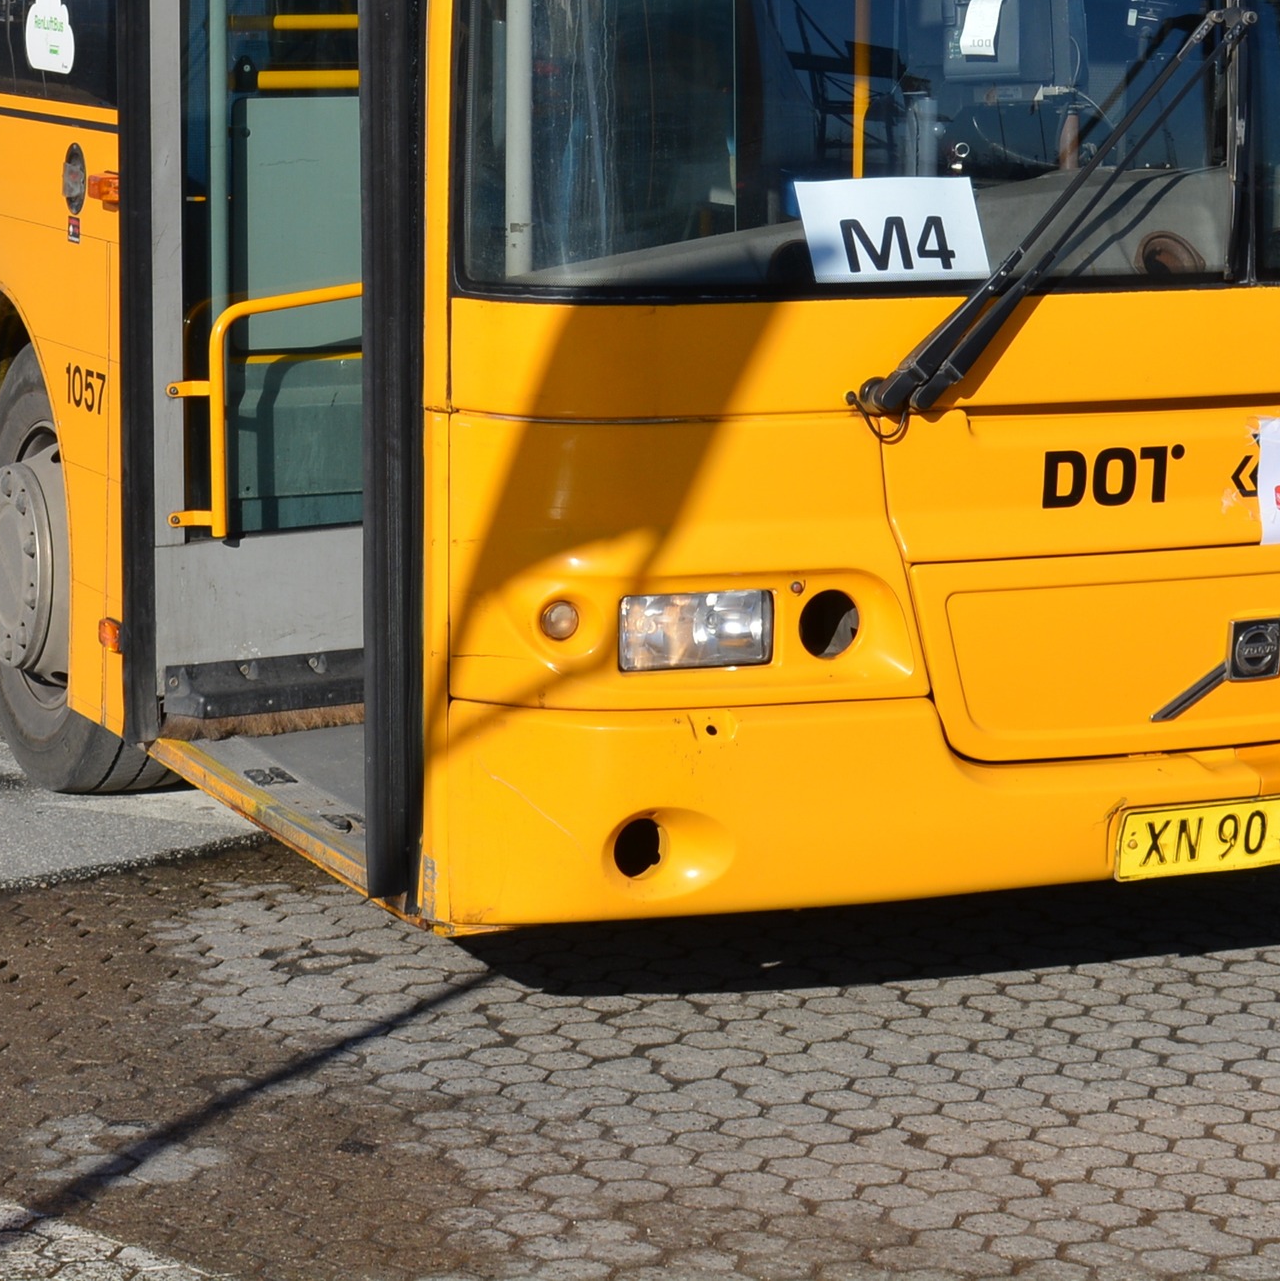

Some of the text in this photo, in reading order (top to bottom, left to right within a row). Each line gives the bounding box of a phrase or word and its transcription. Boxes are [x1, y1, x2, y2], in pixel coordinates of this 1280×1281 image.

[839, 215, 956, 274] M4
[65, 362, 106, 416] 1057
[1139, 816, 1204, 867] XN
[1217, 810, 1268, 860] 90
